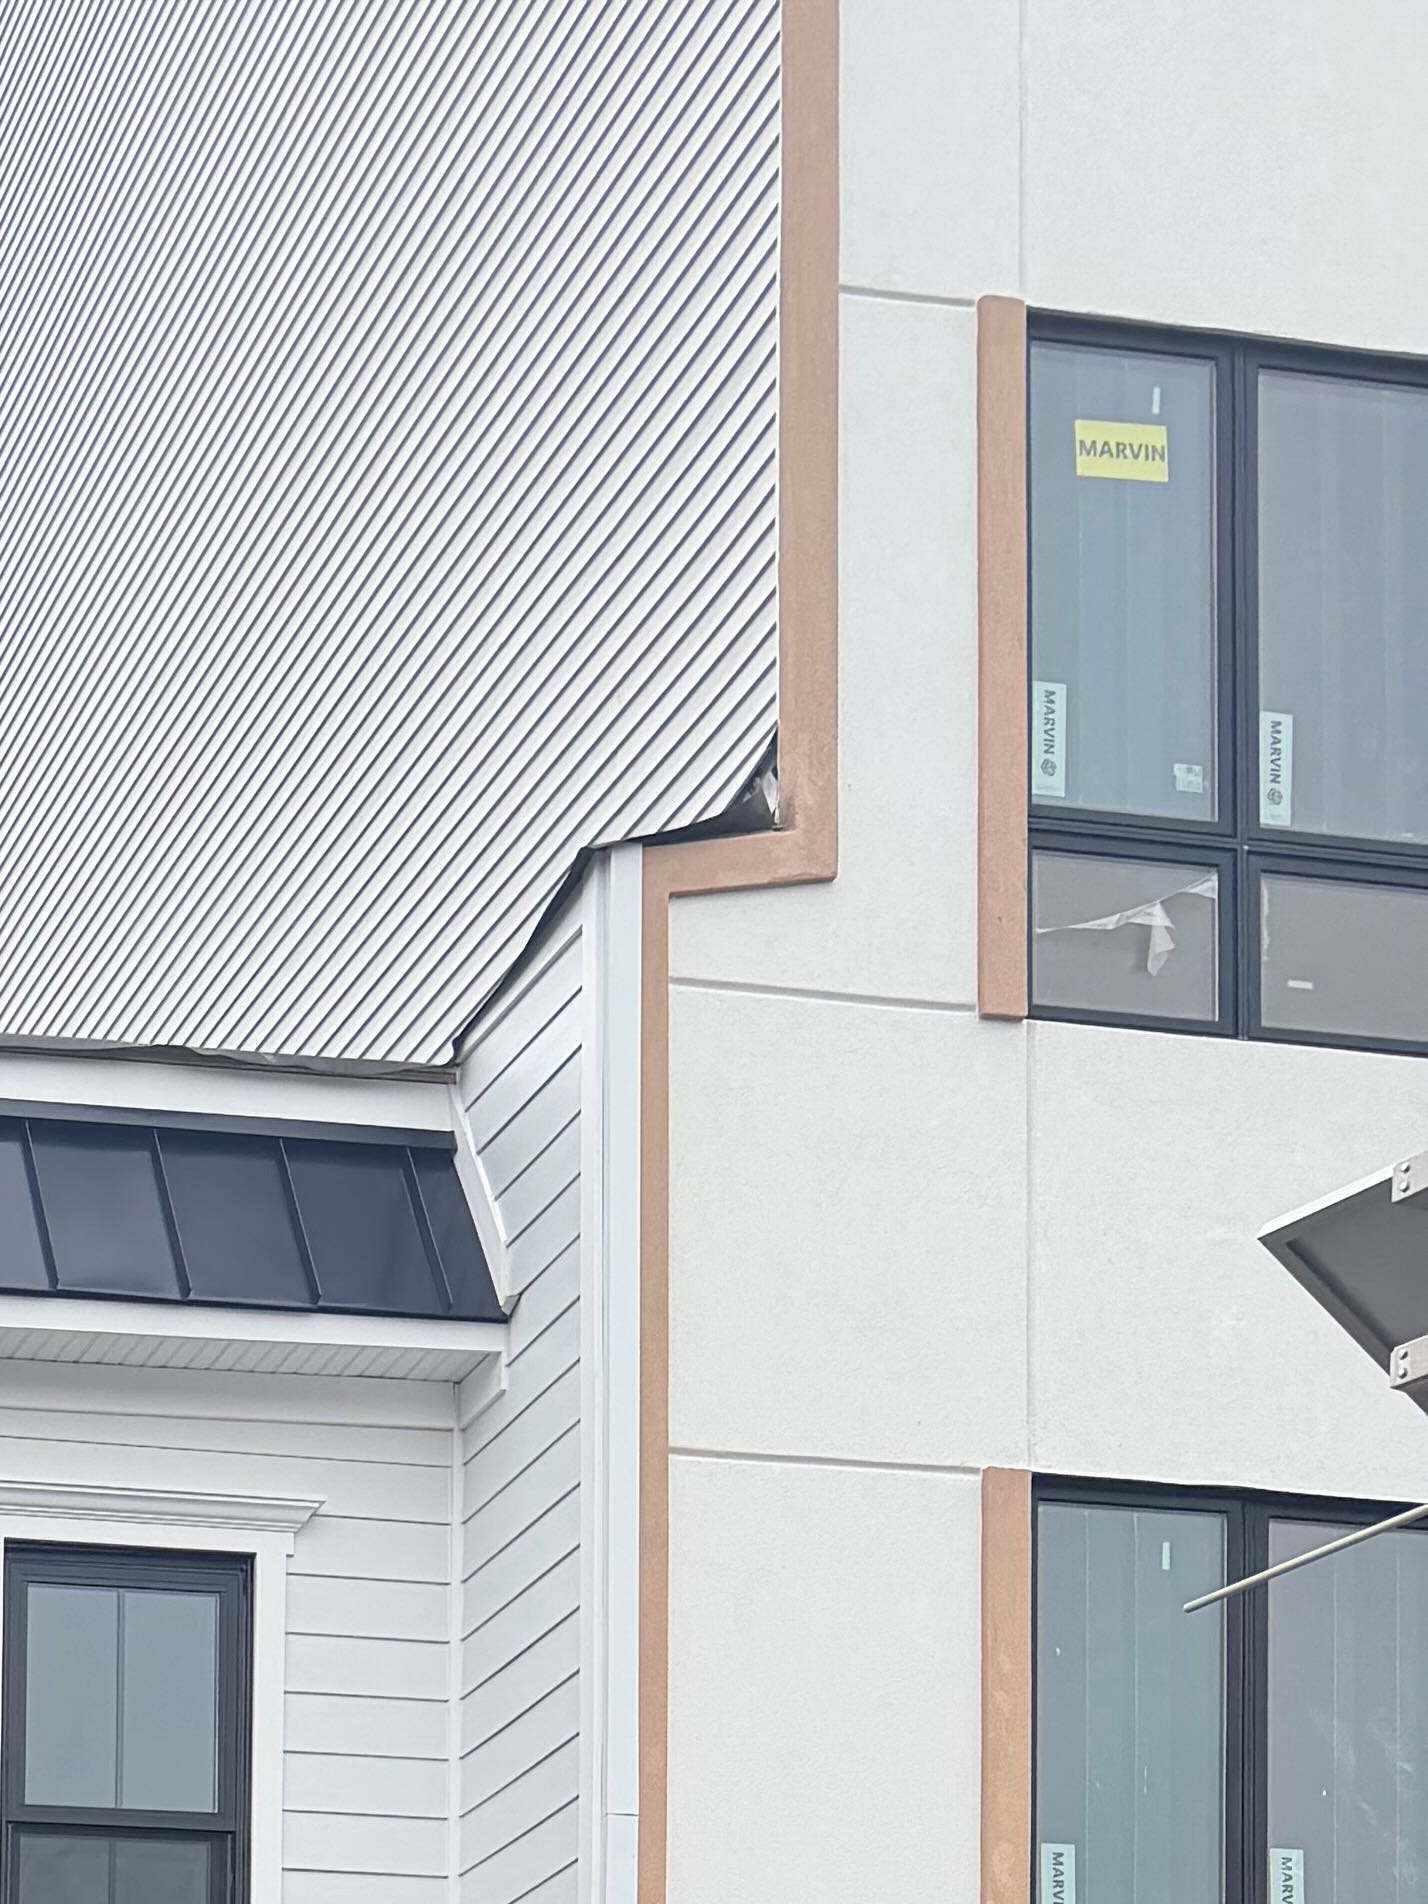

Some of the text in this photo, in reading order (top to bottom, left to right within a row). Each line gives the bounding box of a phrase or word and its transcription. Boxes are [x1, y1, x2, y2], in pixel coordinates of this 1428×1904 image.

[1078, 438, 1166, 463] MARVIN
[1043, 689, 1056, 757] MARVIN
[1269, 719, 1282, 786] MARVIN
